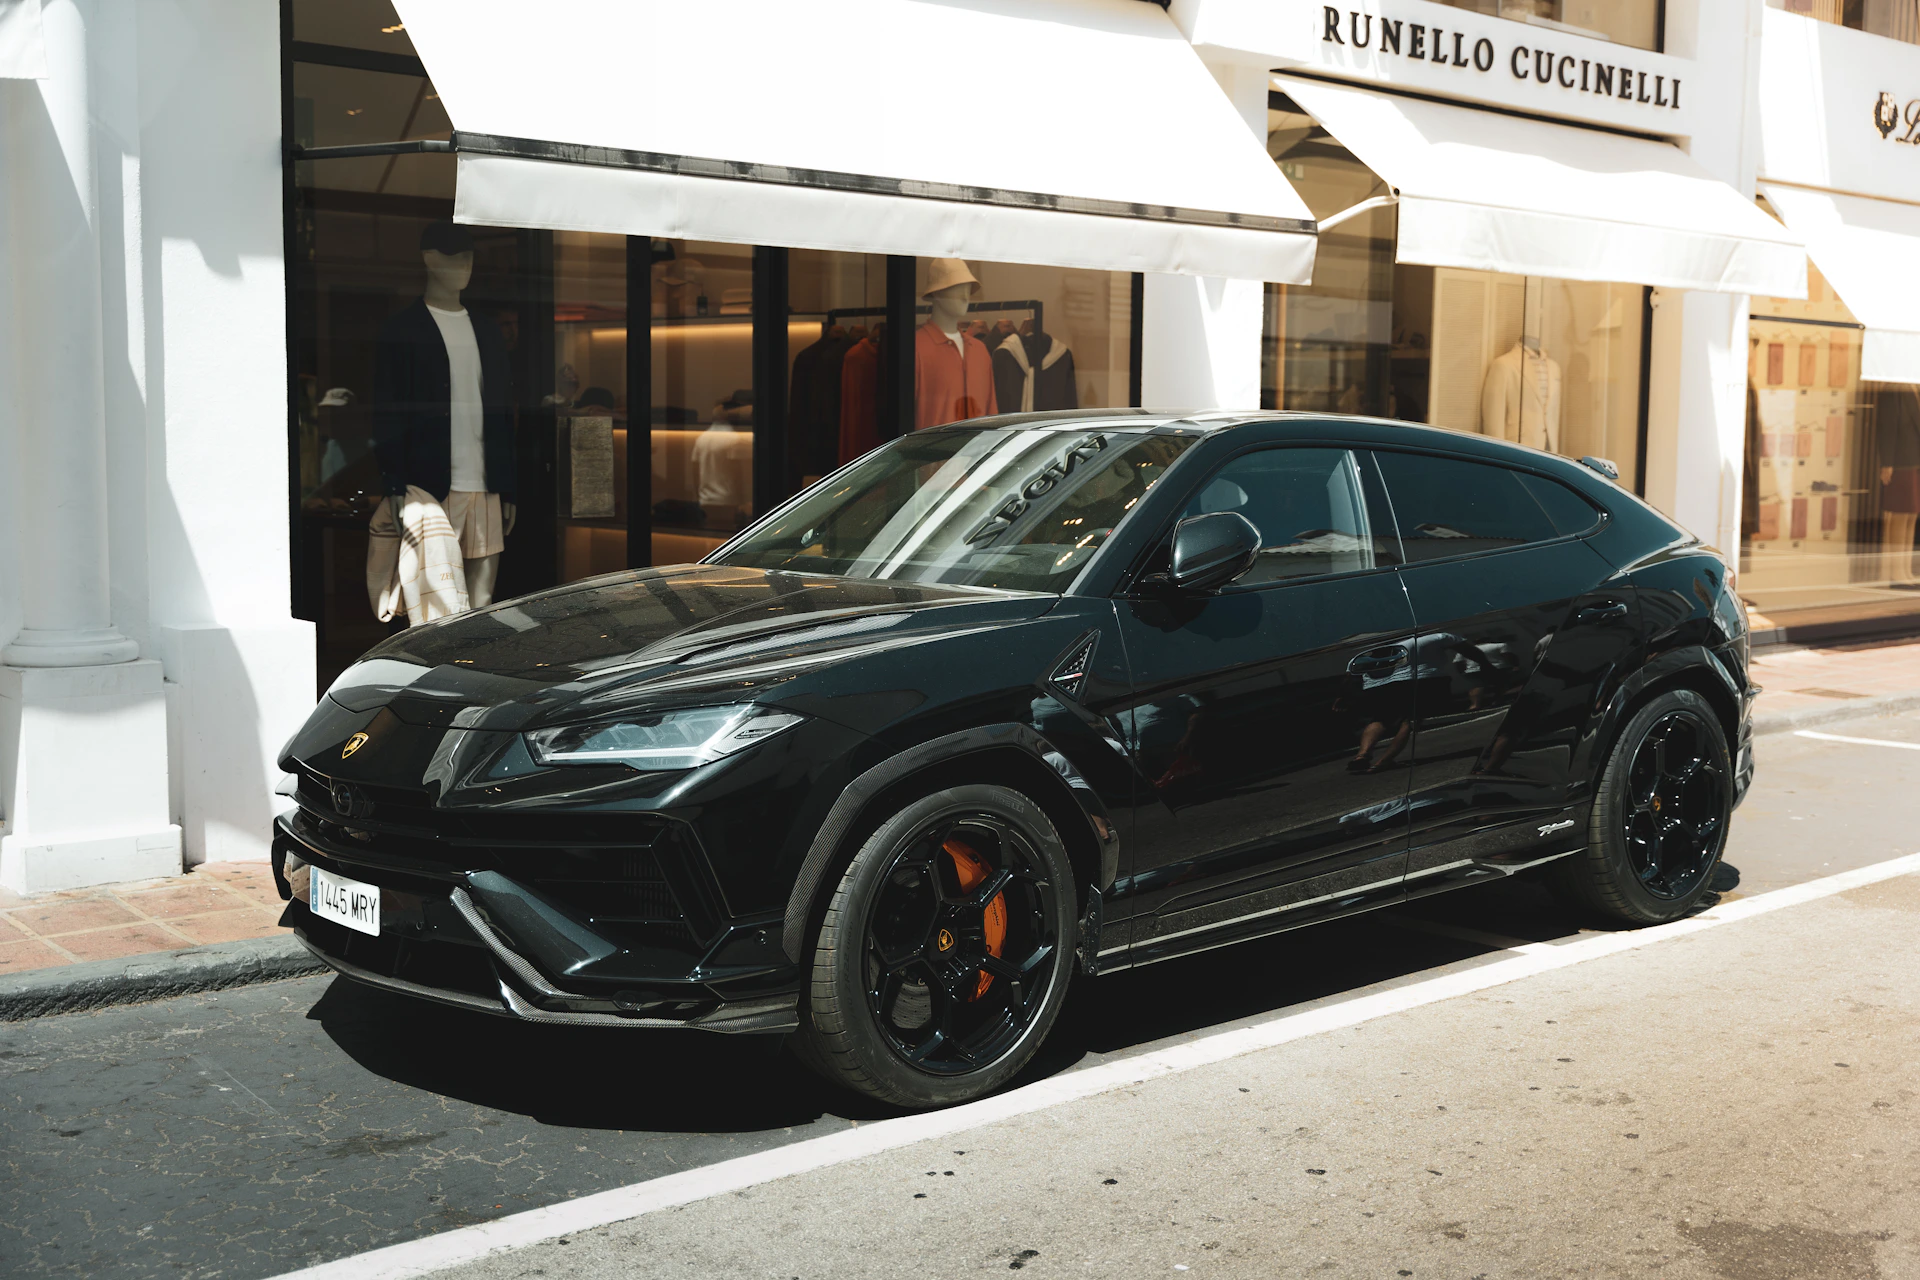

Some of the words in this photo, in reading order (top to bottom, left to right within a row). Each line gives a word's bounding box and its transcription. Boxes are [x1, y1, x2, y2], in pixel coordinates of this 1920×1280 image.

[1322, 5, 1494, 72] RUNELLO
[1511, 45, 1681, 109] CUCINELLI
[320, 880, 347, 915] 1445
[351, 891, 377, 925] MRY
